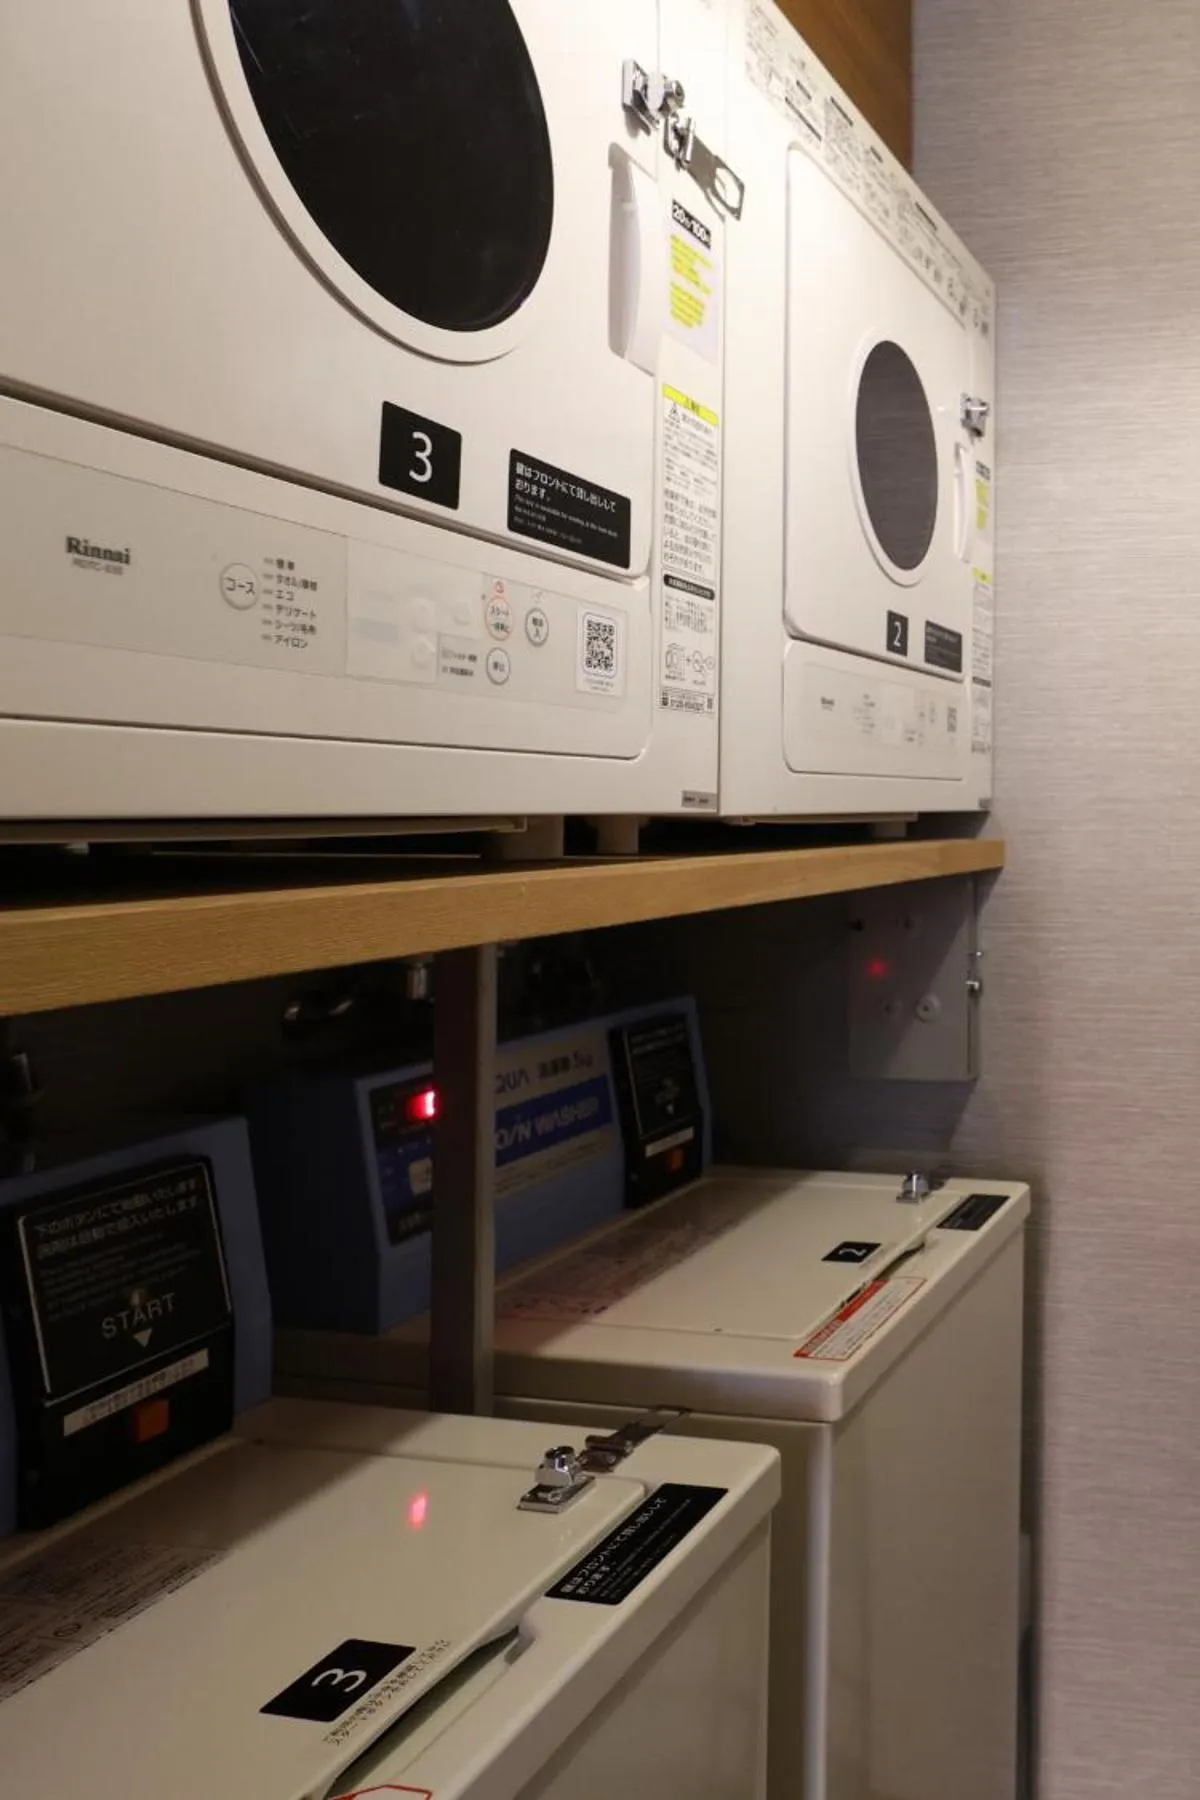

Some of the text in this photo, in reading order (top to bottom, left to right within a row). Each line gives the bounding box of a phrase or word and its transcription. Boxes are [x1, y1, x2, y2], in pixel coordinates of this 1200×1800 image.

[409, 431, 433, 483] 3
[515, 479, 550, 502] おります。
[65, 536, 131, 565] Rinnai
[225, 576, 255, 595] コース
[276, 589, 295, 602] エコ
[274, 634, 309, 649] アイロン
[893, 621, 901, 647] 2
[496, 1068, 531, 1095] QUA
[837, 1247, 867, 1257] 2
[101, 1292, 176, 1339] START
[311, 1668, 367, 1693] 3
